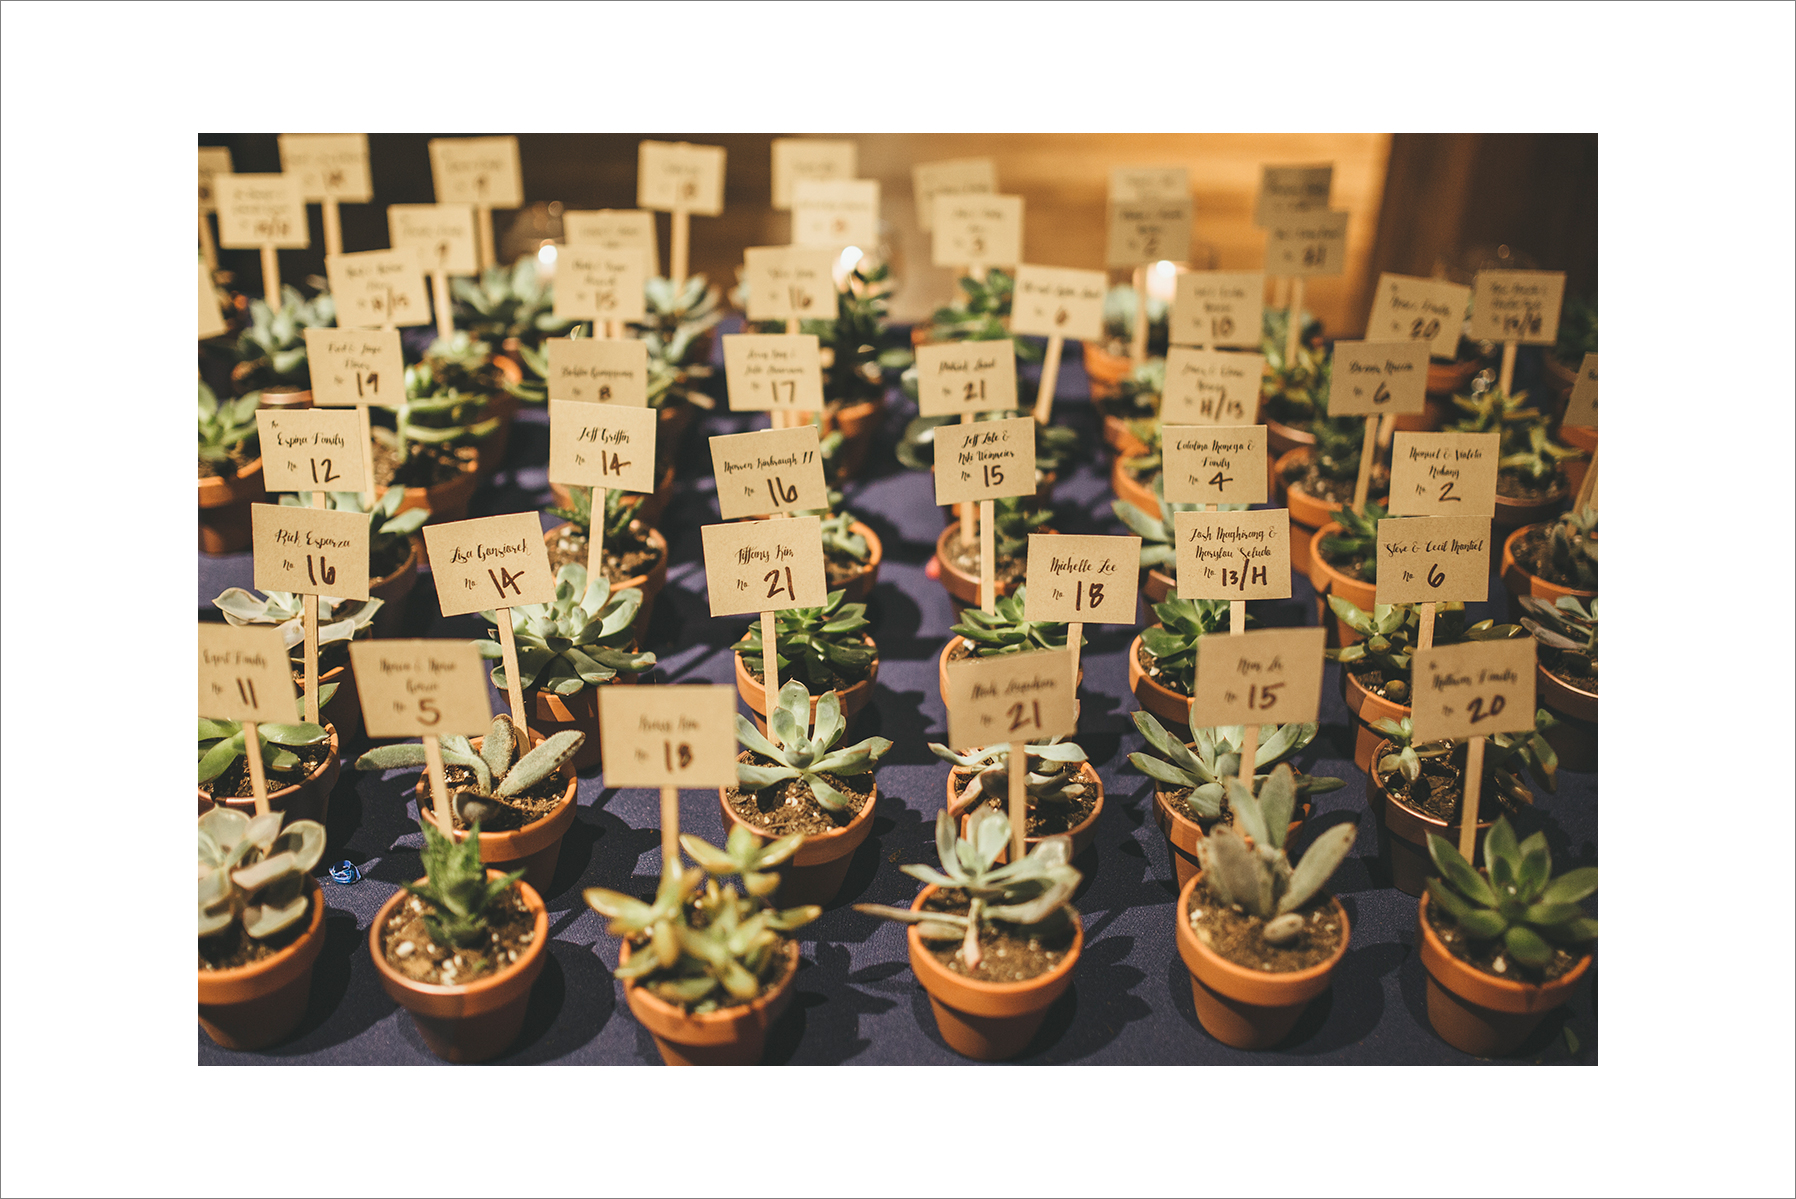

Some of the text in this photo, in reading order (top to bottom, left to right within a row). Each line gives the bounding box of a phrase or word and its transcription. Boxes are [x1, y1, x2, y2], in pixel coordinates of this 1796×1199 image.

[788, 283, 813, 311] 16
[1211, 315, 1236, 338] 10
[356, 371, 378, 398] 19
[771, 379, 796, 404] 17
[963, 378, 986, 402] 21
[1373, 380, 1391, 405] 6
[313, 432, 345, 448] Family
[577, 427, 631, 446] Jeff Griffin
[961, 434, 979, 448] Jeff
[1002, 430, 1010, 441] &
[1176, 440, 1209, 451] Catalina
[1247, 439, 1256, 451] &
[601, 450, 631, 476] 14
[1201, 456, 1230, 470] Family
[1409, 446, 1483, 461] Manuel & Violeta
[311, 458, 340, 484] 12
[983, 464, 1005, 487] 15
[1208, 471, 1234, 492] 4
[767, 476, 798, 507] 16
[1438, 482, 1461, 502] 2
[275, 529, 351, 549] Rick Esparza
[1189, 525, 1278, 543] Josh Maghirang &
[450, 546, 474, 564] Lisa
[734, 544, 794, 565] Tiffany Kim
[1195, 545, 1233, 561] Marylou
[1383, 541, 1408, 557] Steve
[1411, 541, 1420, 553] &
[1425, 540, 1448, 552] Cecil
[307, 554, 336, 586] 16
[1050, 557, 1118, 576] Michelle Lee
[1222, 558, 1268, 591] 13/H
[1427, 563, 1445, 588] 6
[488, 567, 525, 599] 14
[763, 566, 796, 601] 21
[1076, 580, 1104, 611] 18
[236, 677, 258, 710] 11
[1248, 682, 1286, 710] 15
[416, 697, 441, 727] 5
[1006, 698, 1041, 733] 21
[1466, 694, 1506, 724] 20
[664, 739, 693, 774] 18
